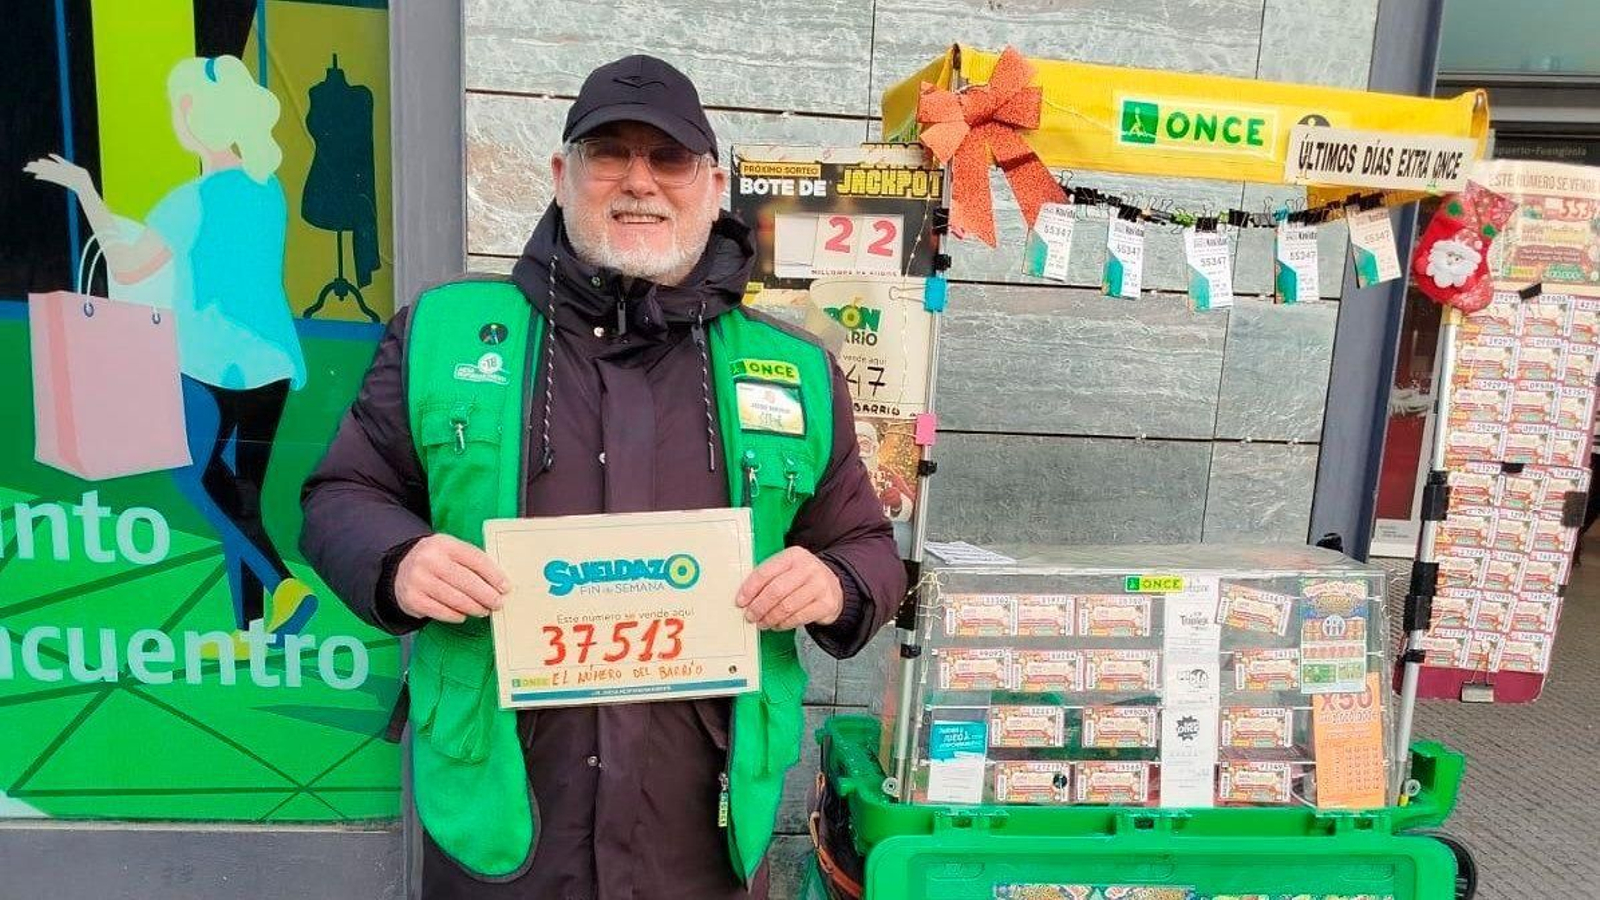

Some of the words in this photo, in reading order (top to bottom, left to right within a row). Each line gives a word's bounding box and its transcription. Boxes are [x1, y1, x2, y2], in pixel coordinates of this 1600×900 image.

[1166, 111, 1265, 147] ONCE
[783, 165, 818, 176] SORTEO
[1298, 133, 1356, 175] ÚLTIMOS
[1362, 139, 1392, 174] DÍAS
[1398, 148, 1429, 179] EXTRA
[1432, 151, 1464, 180] ONCE
[740, 178, 795, 195] BOTE
[799, 179, 827, 196] DE
[836, 168, 942, 198] JACKPOT
[749, 362, 795, 379] ONCE
[0, 490, 171, 565] nto
[544, 553, 700, 597] SUELDAZO
[580, 585, 600, 596] FIN
[615, 582, 665, 594] SEMANA
[1142, 579, 1180, 589] ONCE
[557, 614, 579, 624] Este
[639, 609, 669, 619] vende
[0, 617, 370, 691] cuentro
[542, 618, 685, 666] 37513
[633, 668, 650, 679] DEL
